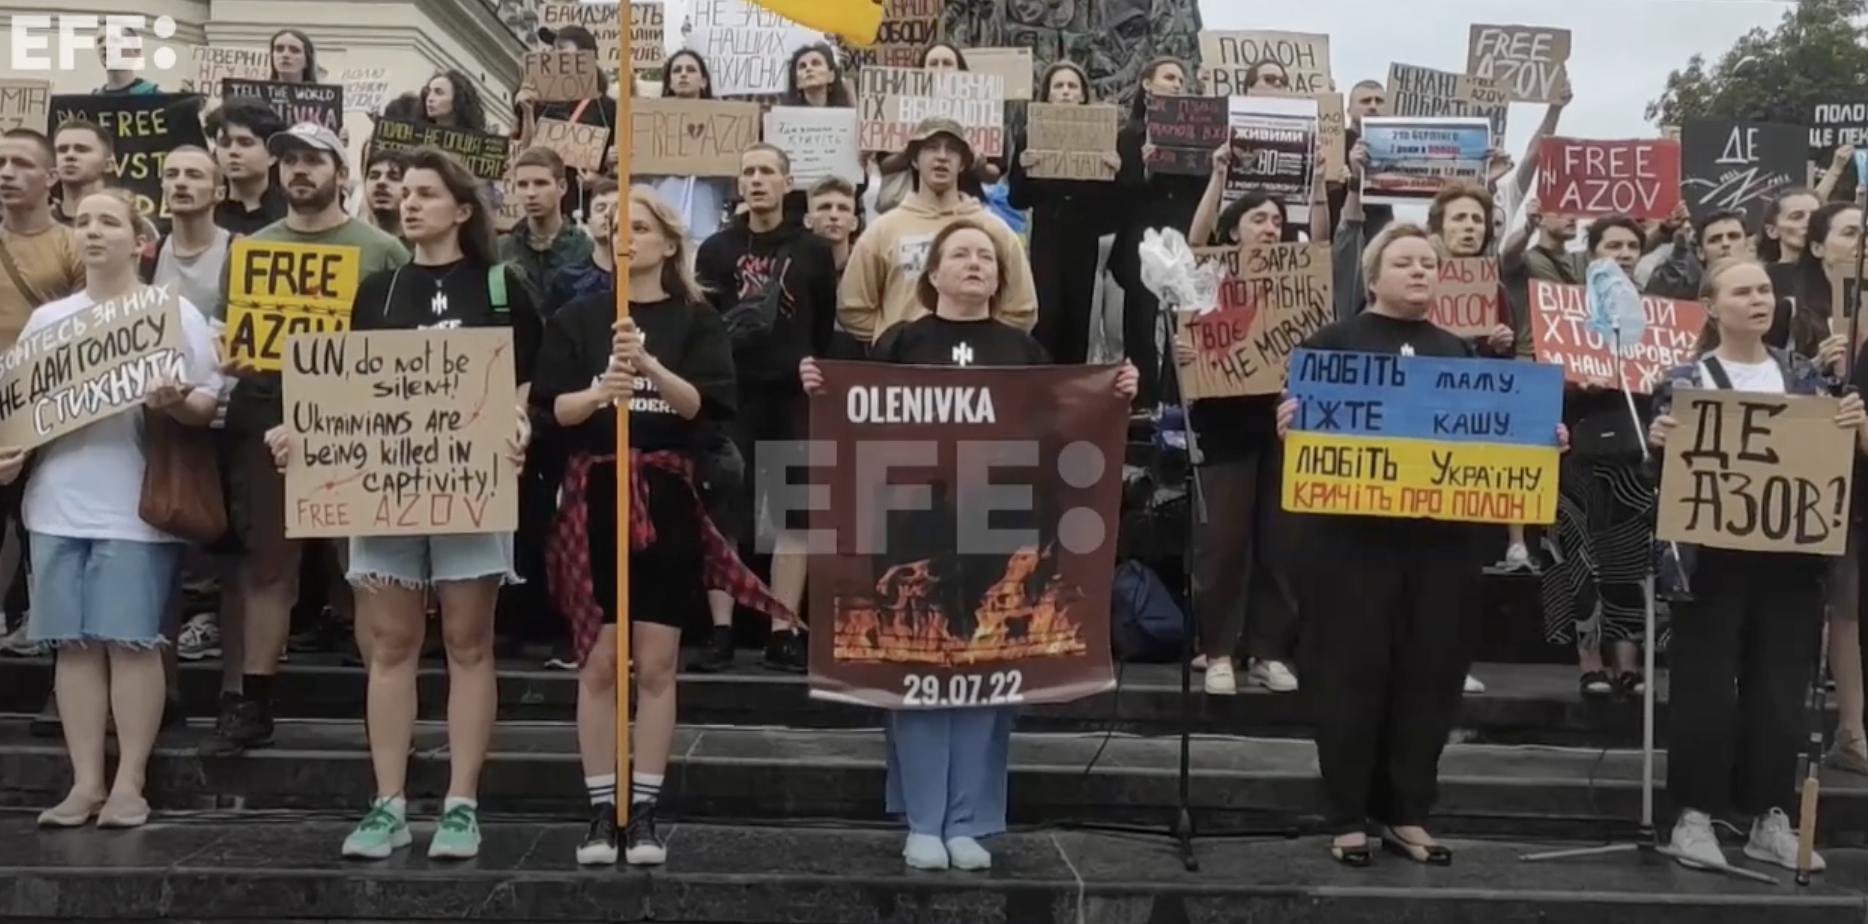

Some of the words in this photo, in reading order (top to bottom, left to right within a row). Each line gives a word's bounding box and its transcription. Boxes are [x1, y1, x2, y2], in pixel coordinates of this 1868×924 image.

[1219, 37, 1316, 69] ПОЛОН
[1475, 28, 1553, 62] FREE
[525, 53, 588, 75] FREE
[1815, 104, 1868, 124] ПОЛО
[630, 110, 691, 159] FREE
[1234, 127, 1304, 143] ЖИВИМИ
[1714, 125, 1760, 164] ДЕ
[1809, 127, 1833, 149] ЦЕ
[1565, 145, 1657, 179] FREE
[1558, 179, 1661, 213] AZOV
[244, 250, 343, 297] FREE
[1248, 246, 1312, 274] ЗАРАЗ
[123, 283, 171, 316] НИХ
[1184, 312, 1248, 351] ТВОЄ
[29, 342, 73, 401] ДАЙ
[76, 312, 166, 374] ГОЛОСУ
[355, 337, 384, 375] do
[443, 339, 470, 375] be
[1300, 353, 1406, 387] ЛЮБІТЬ
[33, 348, 188, 436] СТИХНУТИ
[846, 386, 996, 424] OLENIVKA
[1295, 394, 1383, 431] ЇЖТЕ
[380, 435, 439, 467] killed
[1680, 399, 1788, 471] ДЕ
[296, 498, 351, 528] FREE
[373, 493, 490, 529] AZOV
[1401, 487, 1443, 514] ПРО
[1452, 490, 1525, 520] ПОЛОН
[1679, 469, 1847, 545] АЗОВ!
[902, 669, 1024, 706] 29.07.22
